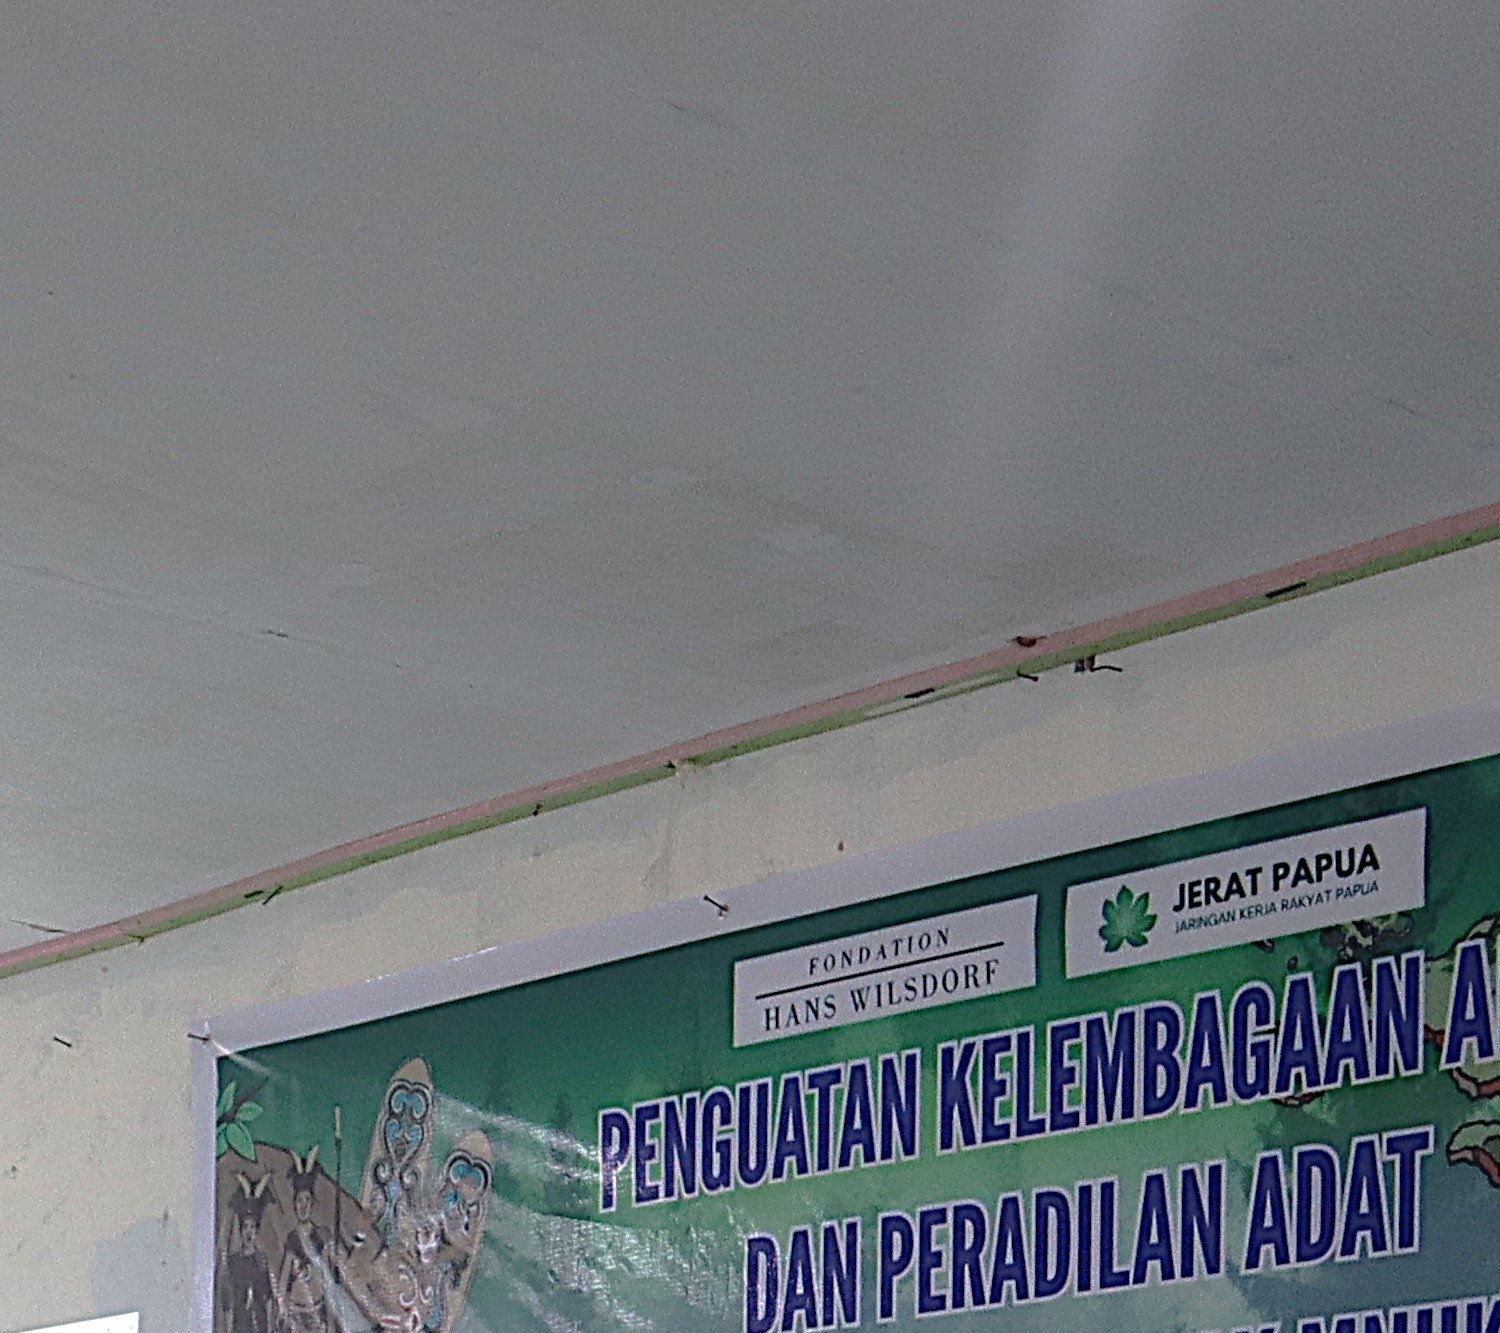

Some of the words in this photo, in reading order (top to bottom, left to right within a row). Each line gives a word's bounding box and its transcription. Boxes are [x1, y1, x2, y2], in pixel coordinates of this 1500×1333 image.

[1172, 866, 1262, 912] JERAT
[1273, 843, 1380, 892] PAPUA
[1175, 909, 1236, 934] JARINGAN
[1239, 902, 1277, 920] KERJA
[1281, 889, 1332, 912] RAKYAT
[1335, 880, 1379, 900] PAPUA
[809, 927, 951, 976] FONDATION
[764, 993, 838, 1032] HANS
[850, 958, 1001, 1014] WILSDORF
[600, 1048, 921, 1213] PENGUATAN
[938, 950, 1427, 1154] KELEMBAGAAN
[877, 1160, 1226, 1323] PERADILAN
[1241, 1125, 1435, 1276] ADAT
